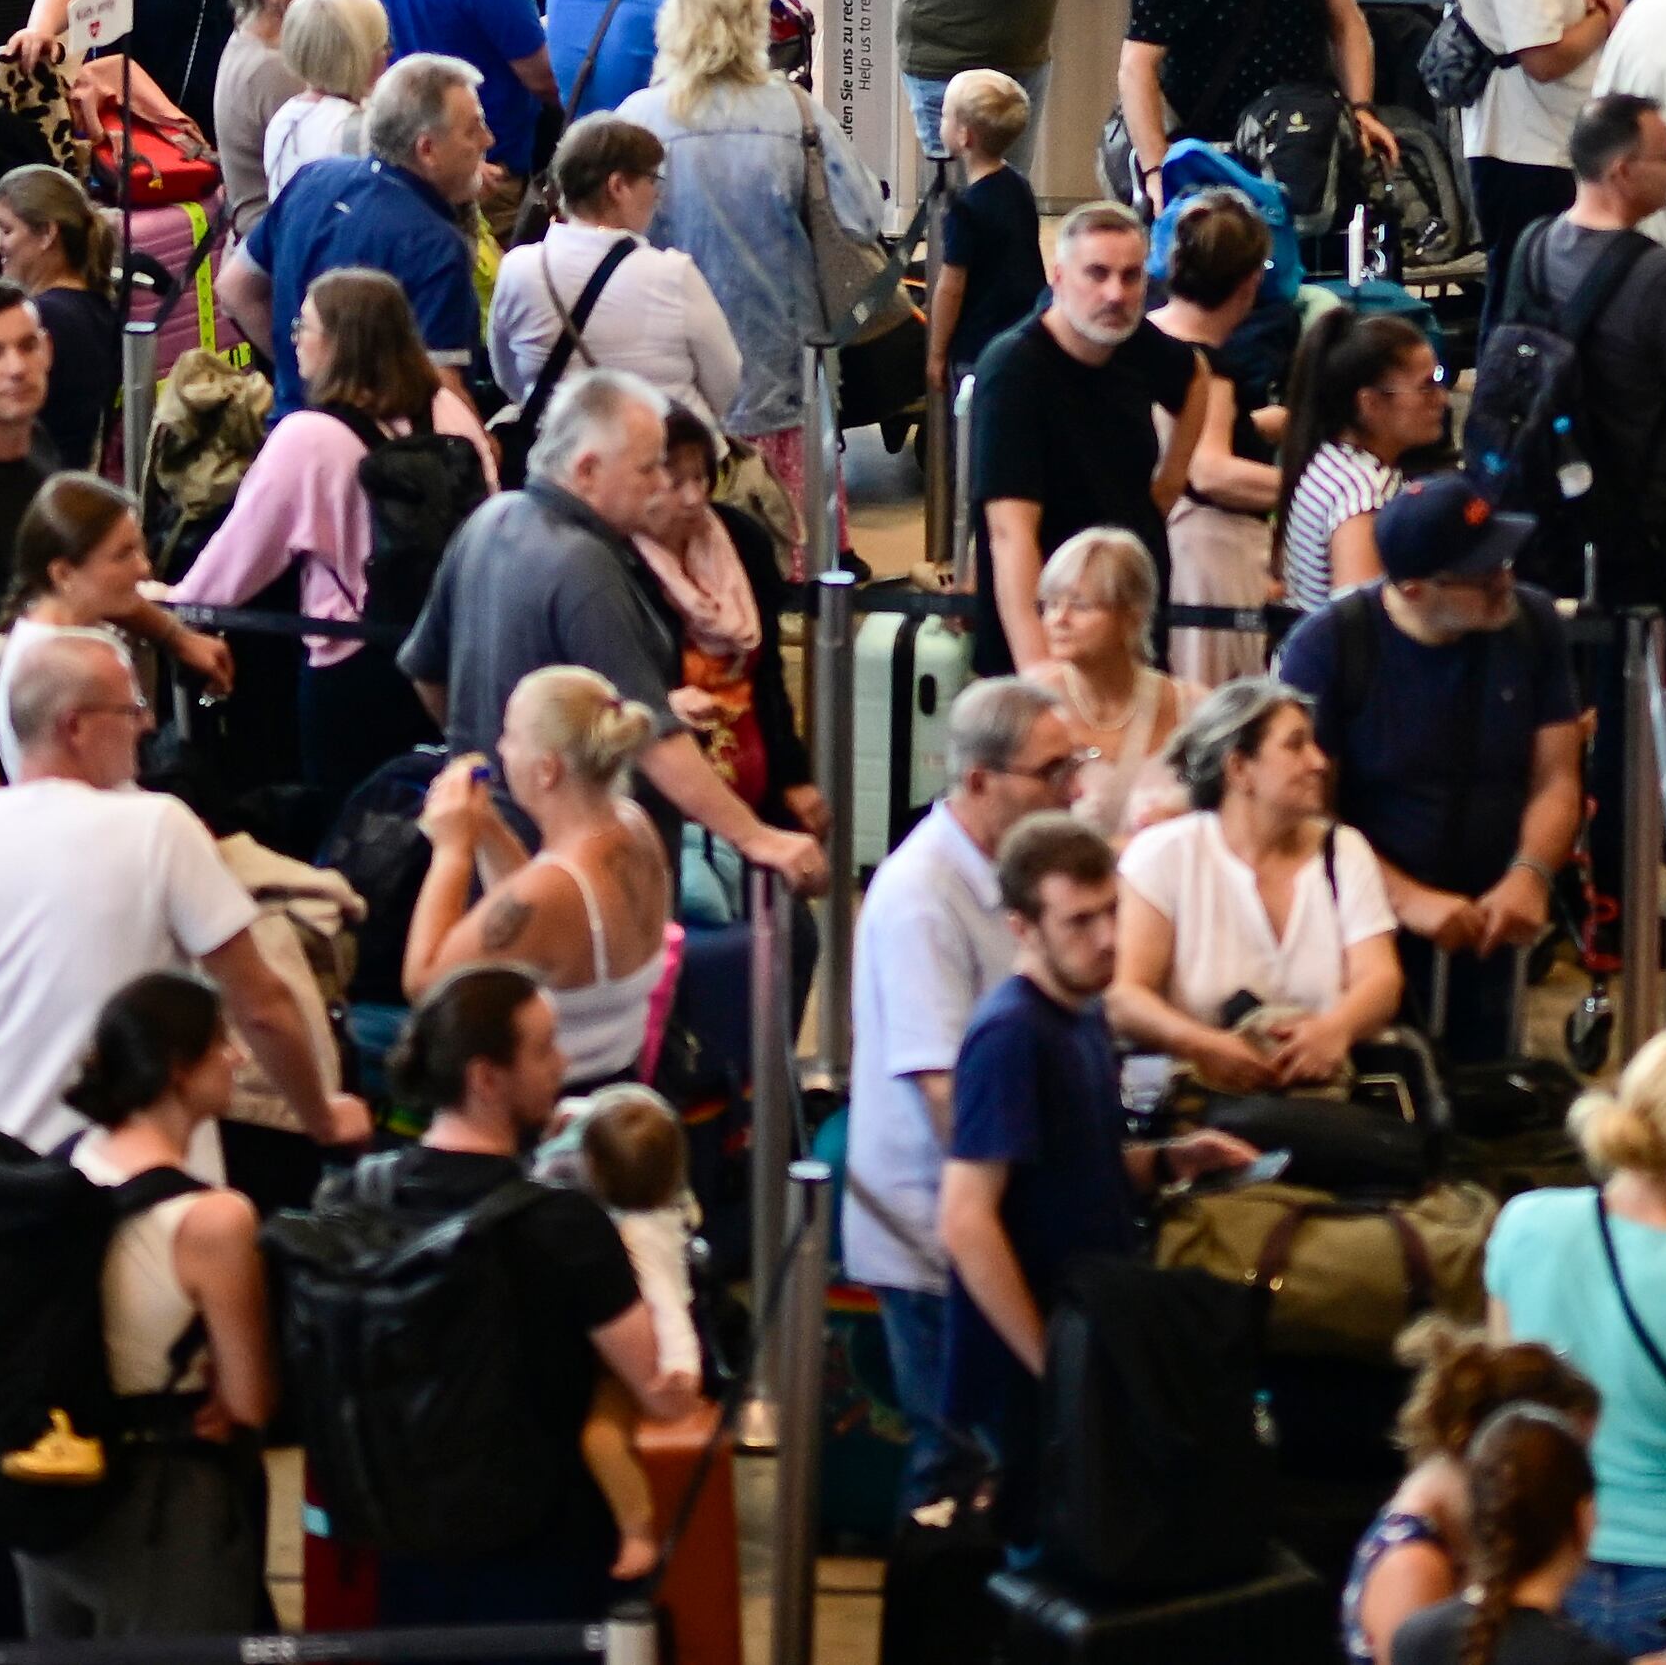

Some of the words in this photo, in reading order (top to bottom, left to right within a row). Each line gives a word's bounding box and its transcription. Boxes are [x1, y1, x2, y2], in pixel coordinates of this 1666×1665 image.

[859, 16, 871, 33] to
[844, 27, 854, 44] zu
[861, 36, 871, 53] us
[844, 48, 854, 74] uns
[859, 59, 873, 91] Help
[840, 81, 854, 101] Sie
